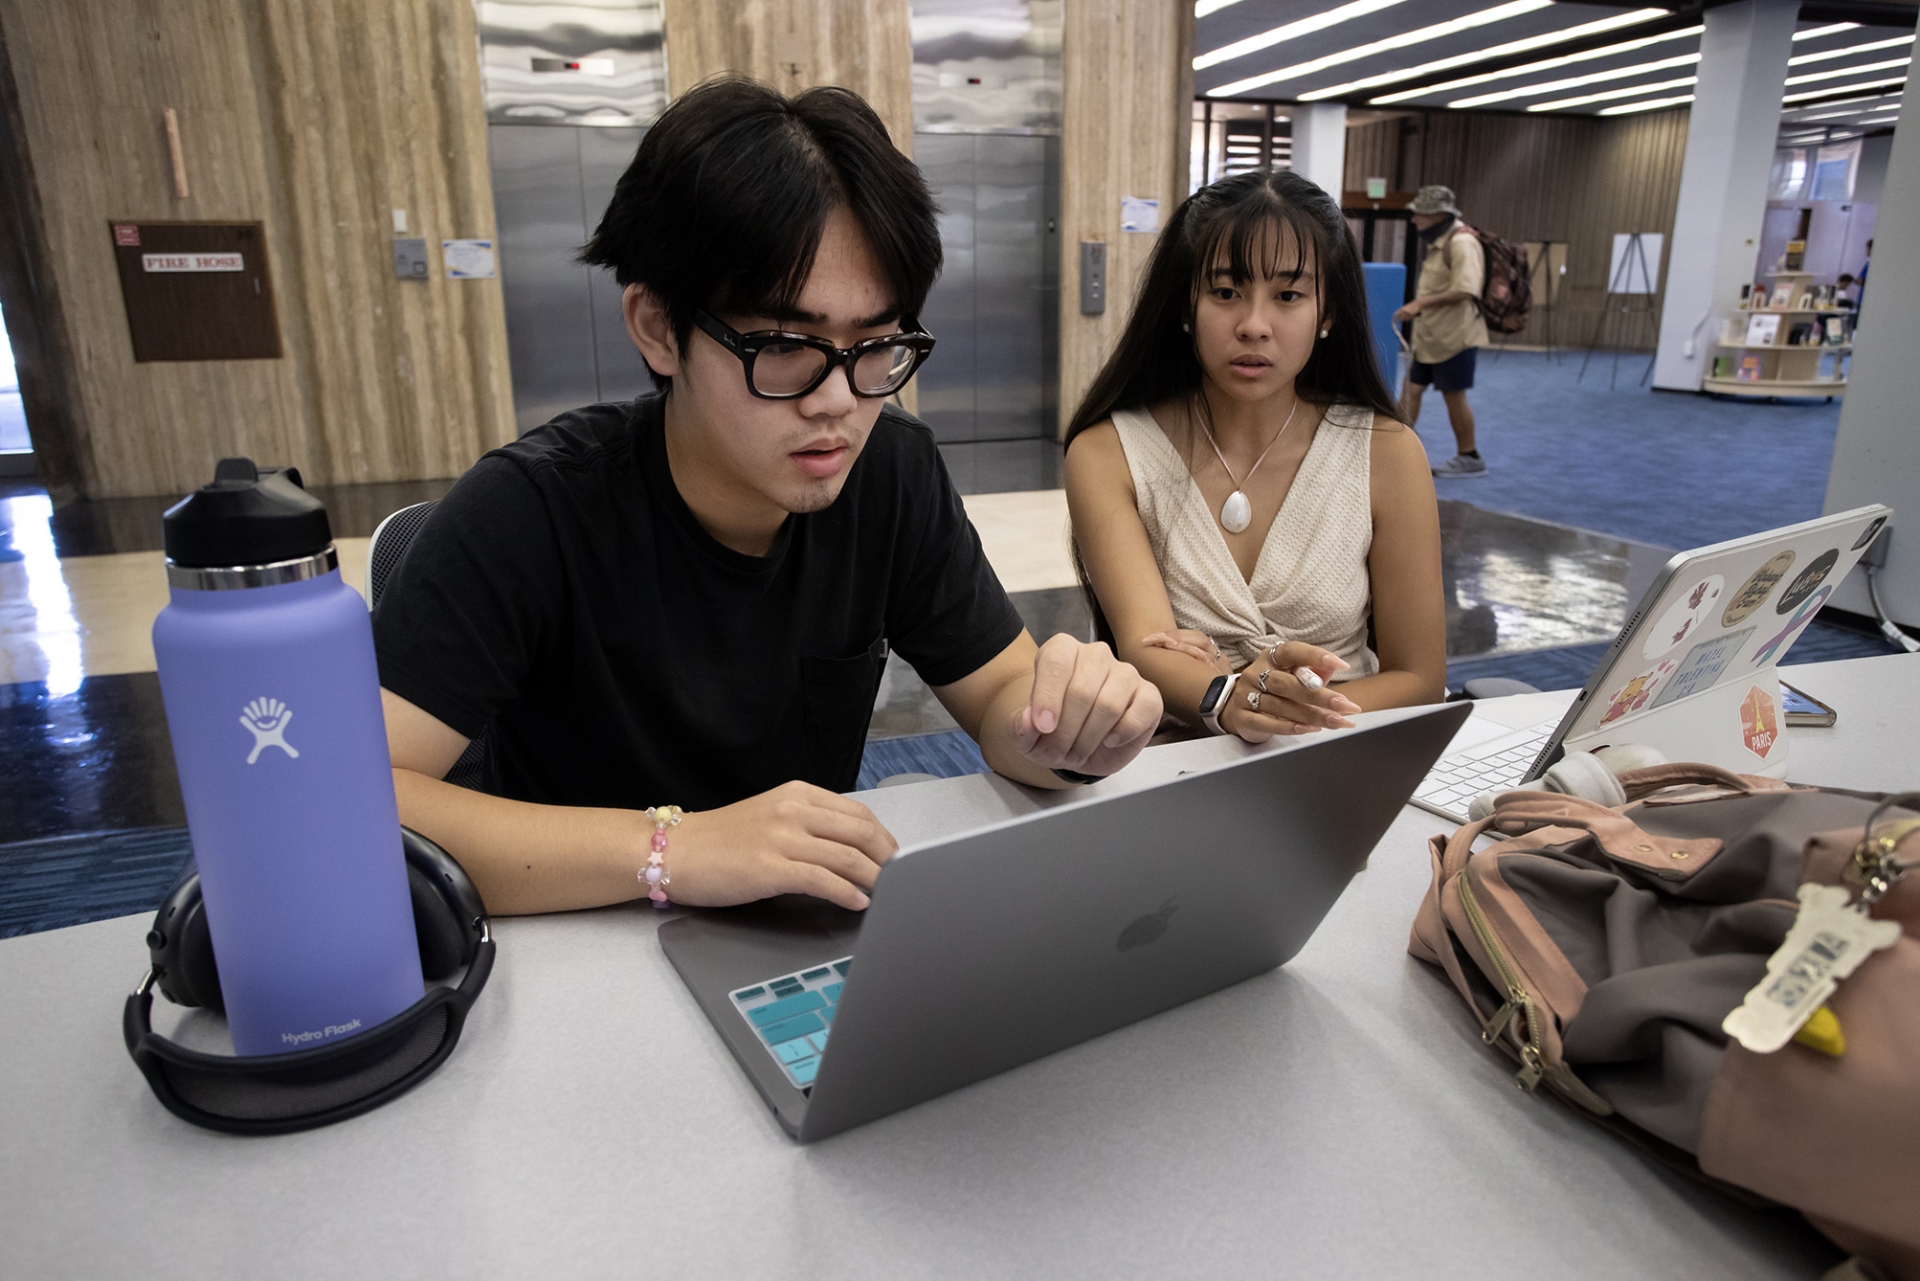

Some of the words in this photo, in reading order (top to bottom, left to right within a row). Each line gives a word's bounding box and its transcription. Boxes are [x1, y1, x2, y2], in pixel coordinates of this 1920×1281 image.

[145, 257, 189, 269] FIRE
[196, 257, 240, 268] HOSE
[1751, 731, 1772, 751] PARIS
[282, 1031, 323, 1045] Hydro
[324, 1019, 361, 1037] Flask
